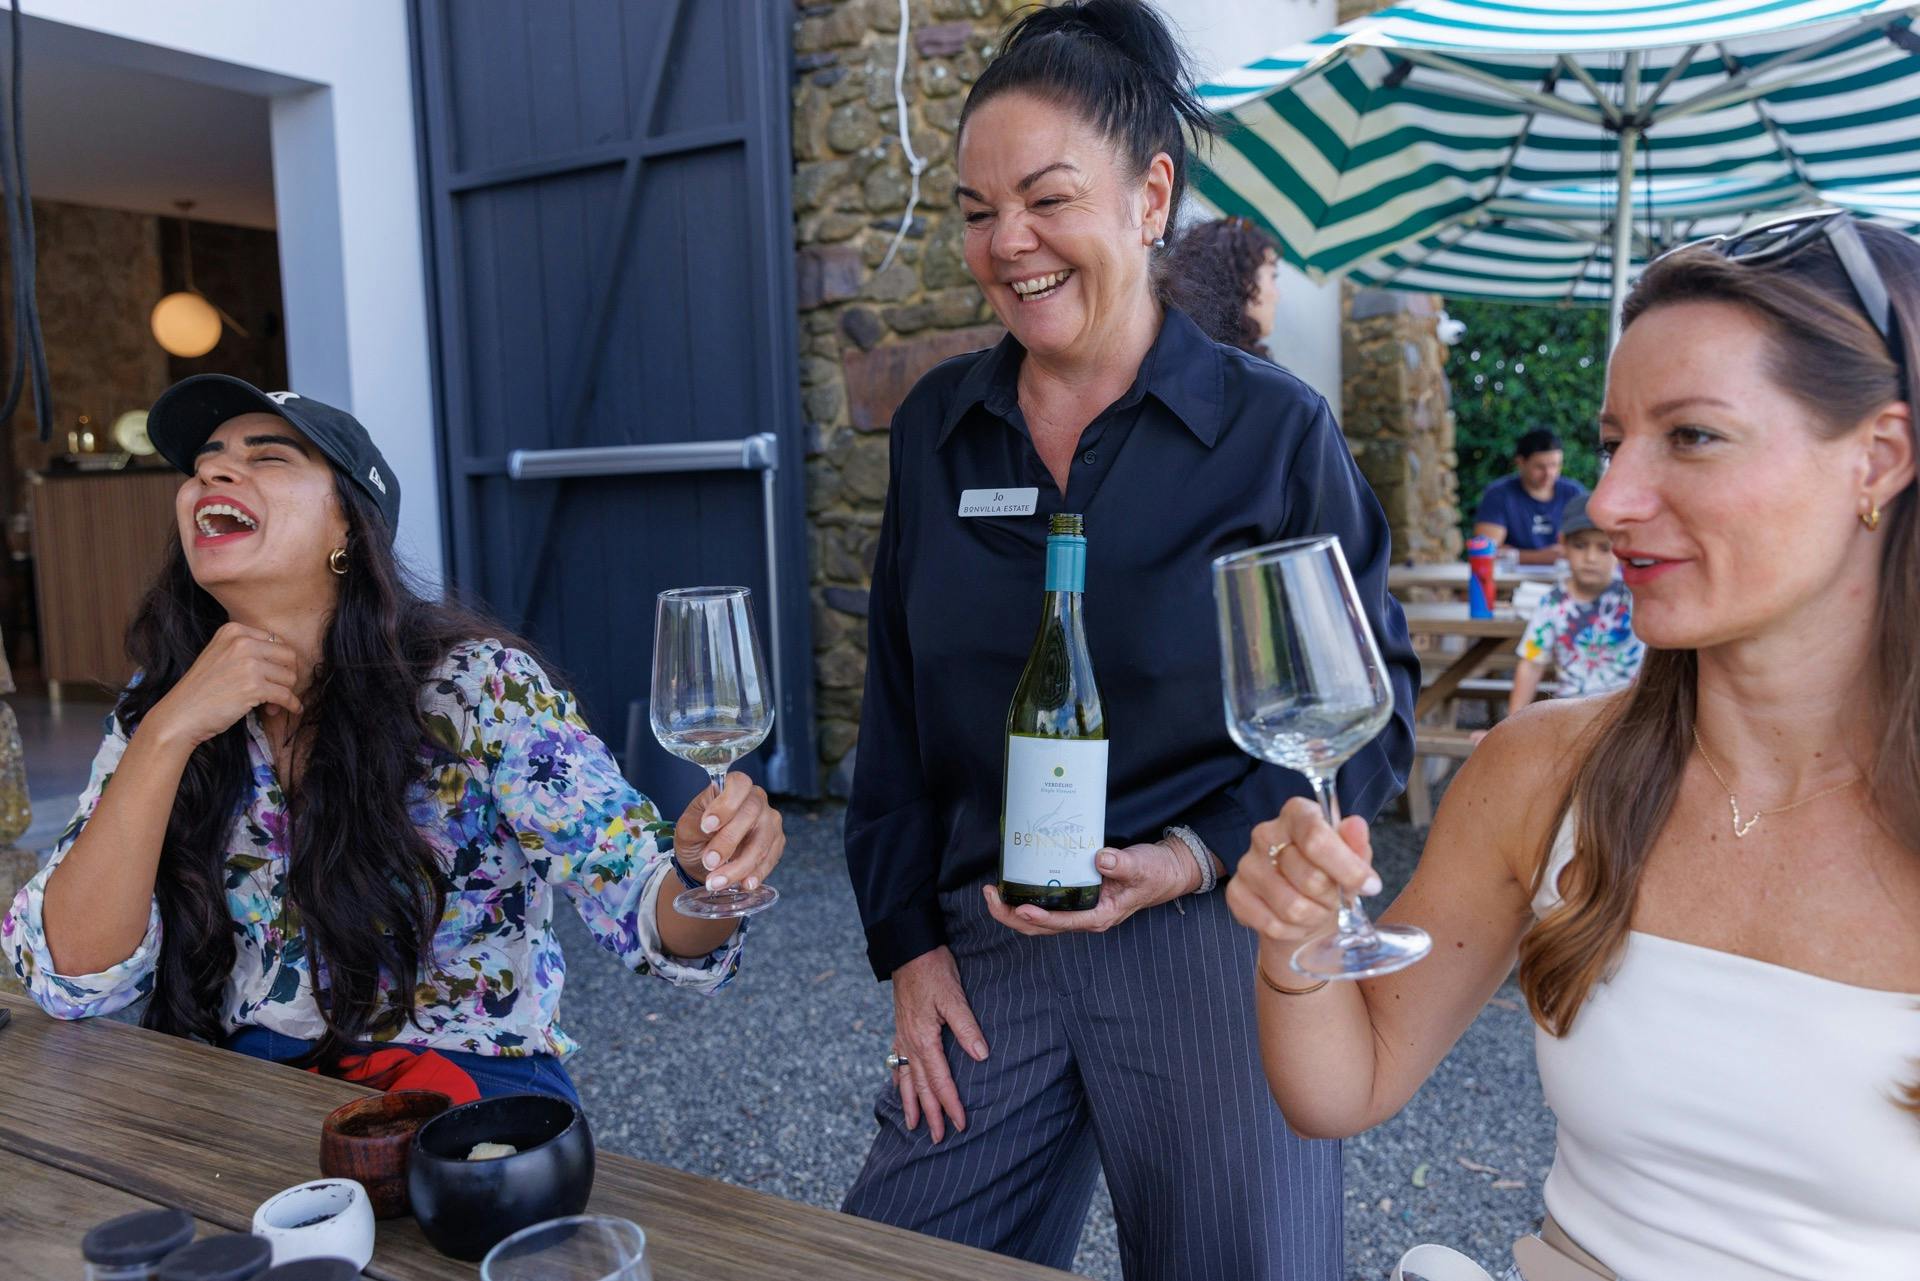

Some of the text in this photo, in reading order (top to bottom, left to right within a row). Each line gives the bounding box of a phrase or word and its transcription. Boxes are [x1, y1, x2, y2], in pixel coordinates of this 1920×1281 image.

[993, 492, 1004, 502] Jo
[963, 504, 1030, 513] BONVILLA ESTATE
